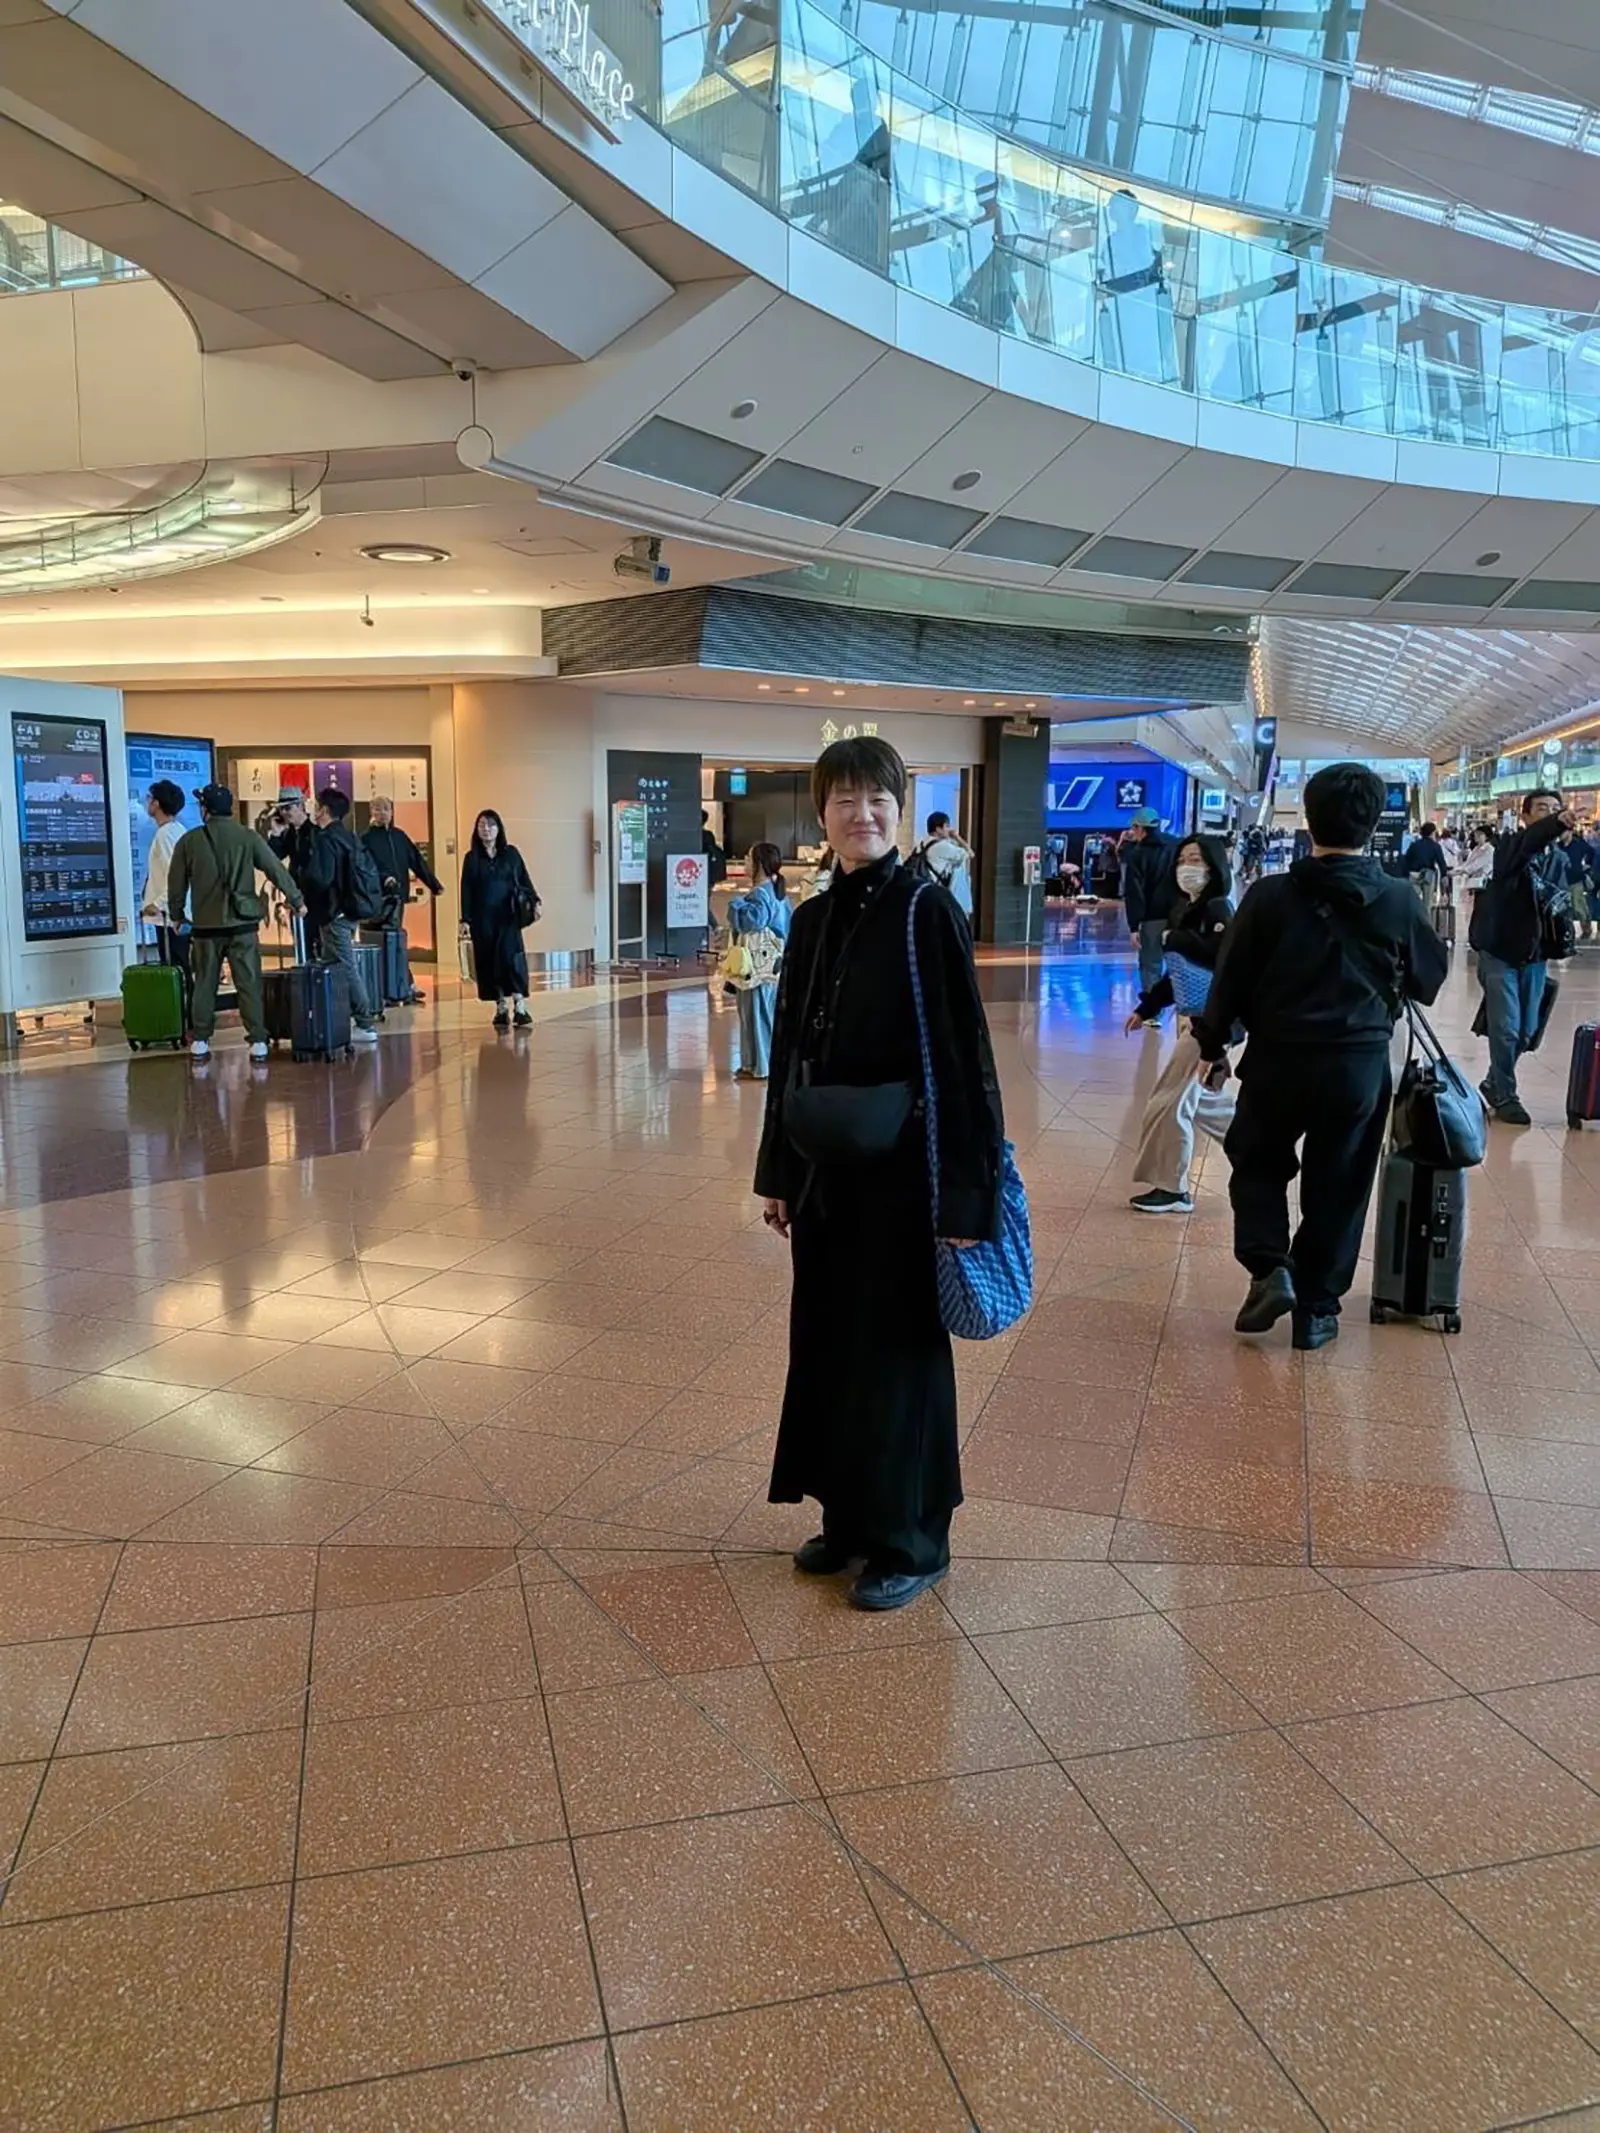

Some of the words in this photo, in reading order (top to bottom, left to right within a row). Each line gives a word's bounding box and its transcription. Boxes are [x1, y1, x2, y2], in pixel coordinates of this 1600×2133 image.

[559, 0, 634, 120] Place
[26, 726, 34, 735] A
[76, 729, 83, 739] C
[1257, 722, 1274, 745] C
[1249, 795, 1260, 808] C
